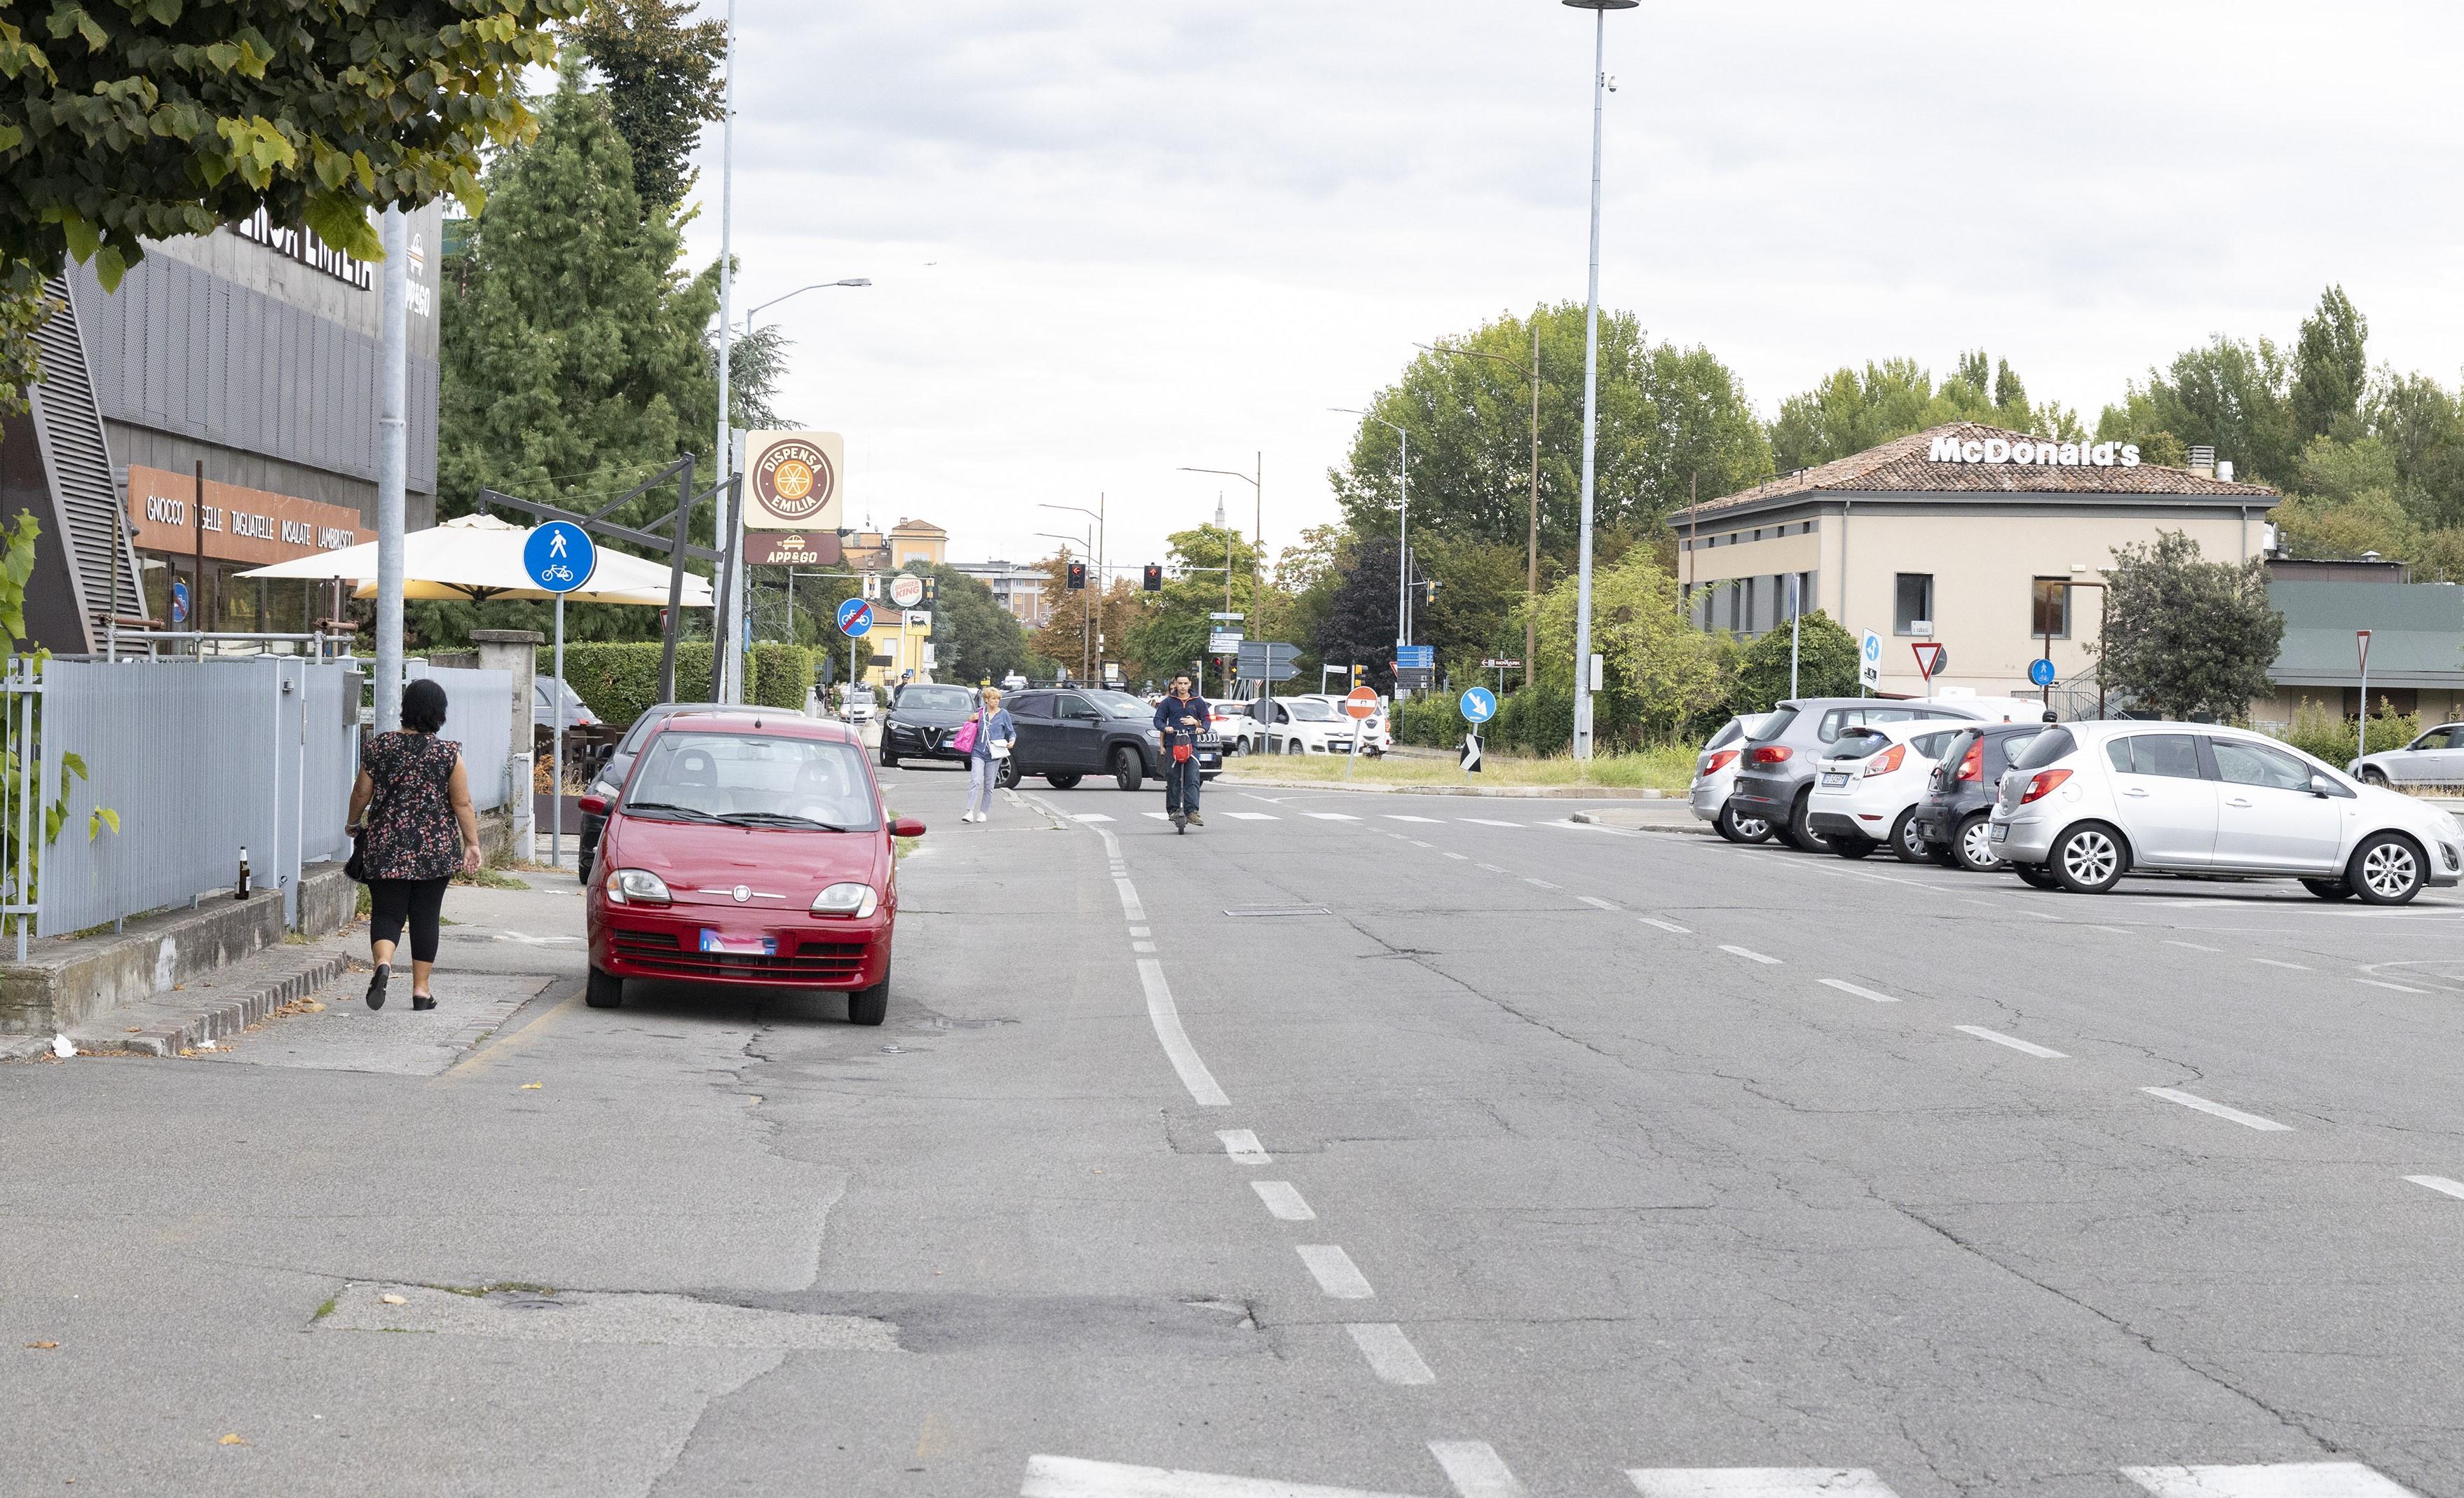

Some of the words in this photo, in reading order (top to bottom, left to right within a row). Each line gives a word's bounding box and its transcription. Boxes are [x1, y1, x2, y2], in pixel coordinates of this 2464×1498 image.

[404, 278, 430, 318] PP&GO
[763, 447, 823, 474] DISPENSA
[1928, 436, 2141, 468] McDonald's
[770, 495, 817, 512] EMILIA
[146, 495, 184, 526] GNOCCO
[192, 503, 223, 532] TGELLE
[231, 510, 275, 540] TAGLIATELLE
[280, 519, 311, 545] INSALATE
[317, 526, 355, 550] LAMBRUSCO
[766, 551, 818, 564] APP&GO
[894, 580, 919, 590] BURGER
[895, 586, 920, 599] KING
